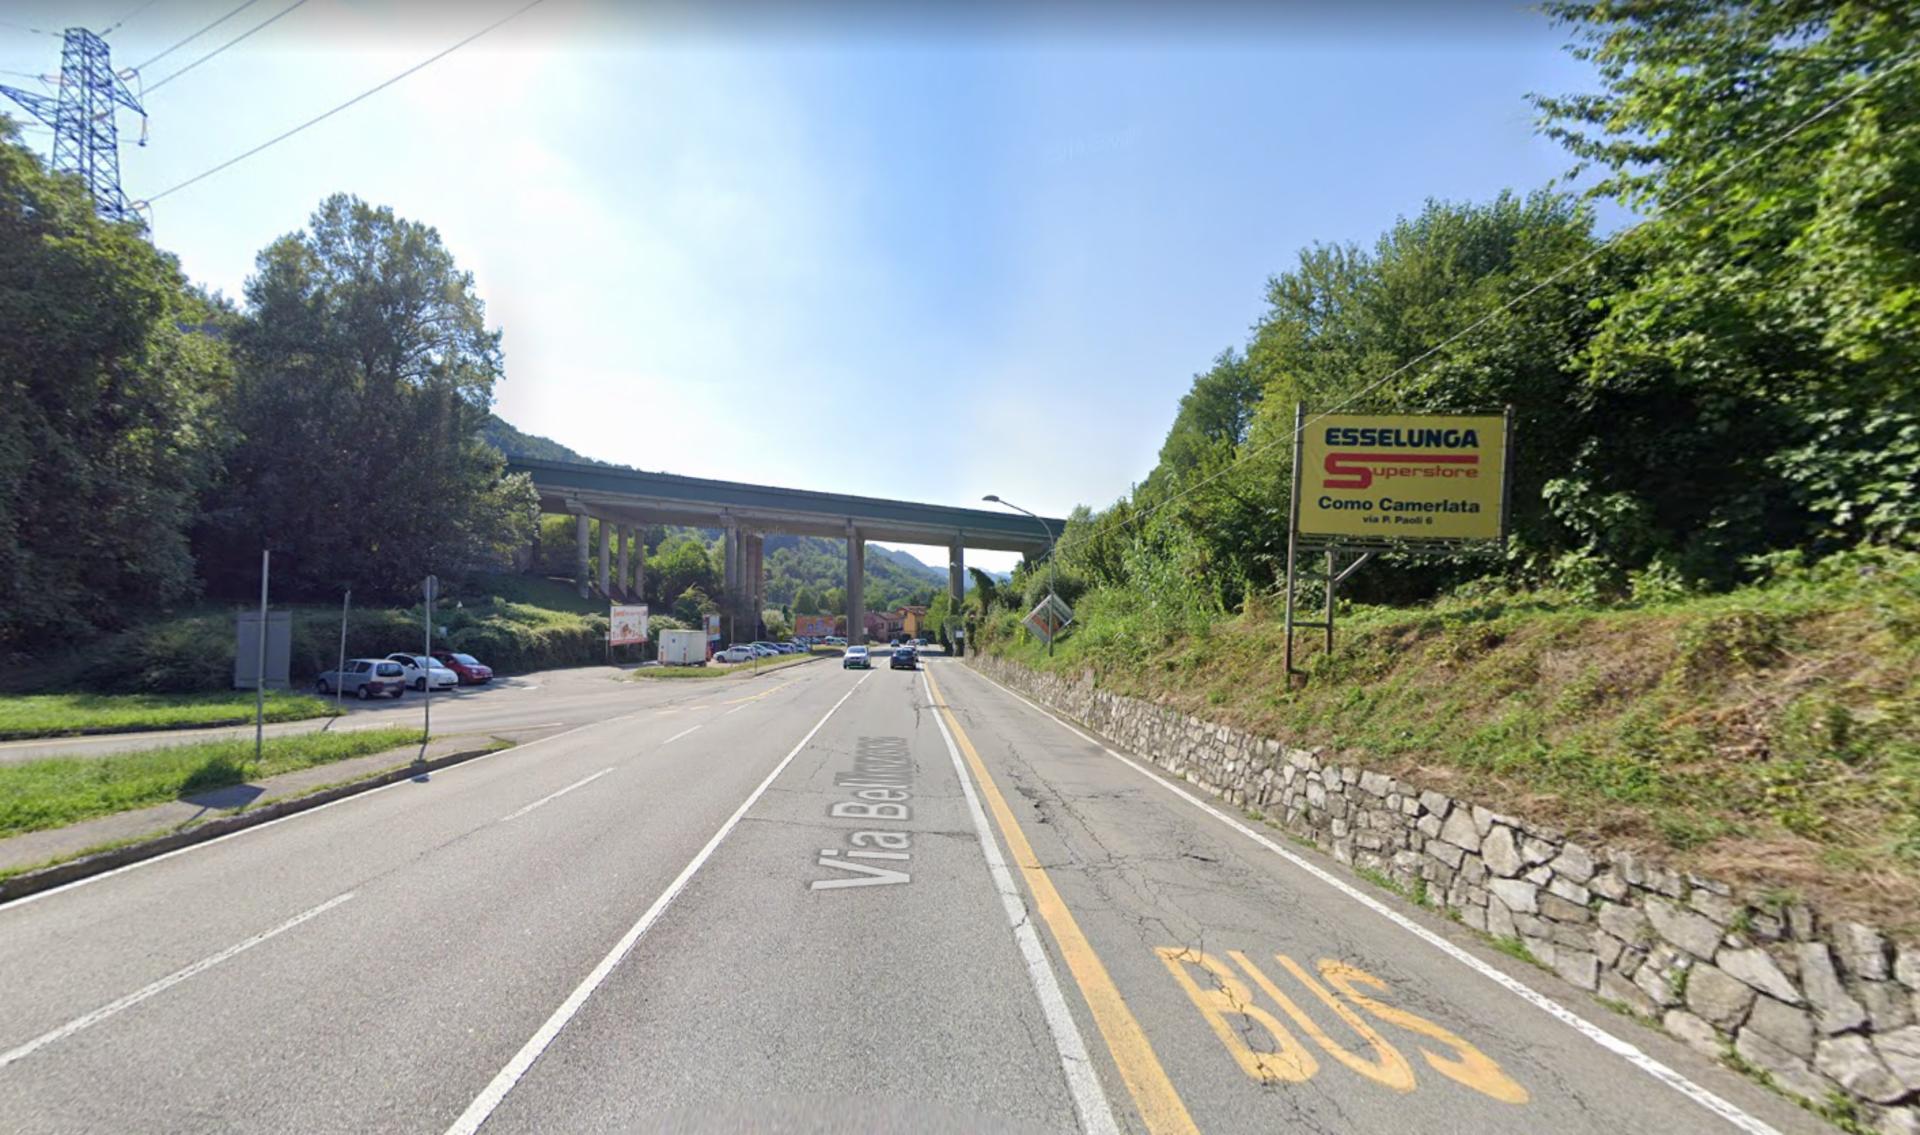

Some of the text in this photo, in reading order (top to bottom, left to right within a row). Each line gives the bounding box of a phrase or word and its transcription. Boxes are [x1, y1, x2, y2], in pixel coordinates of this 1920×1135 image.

[1325, 428, 1479, 448] ESSELUNGA
[1323, 452, 1479, 489] Superstore
[1318, 496, 1480, 513] Como Camerlata
[1362, 515, 1379, 524] via
[1395, 515, 1422, 525] Paoli
[1154, 946, 1530, 1105] BUS
